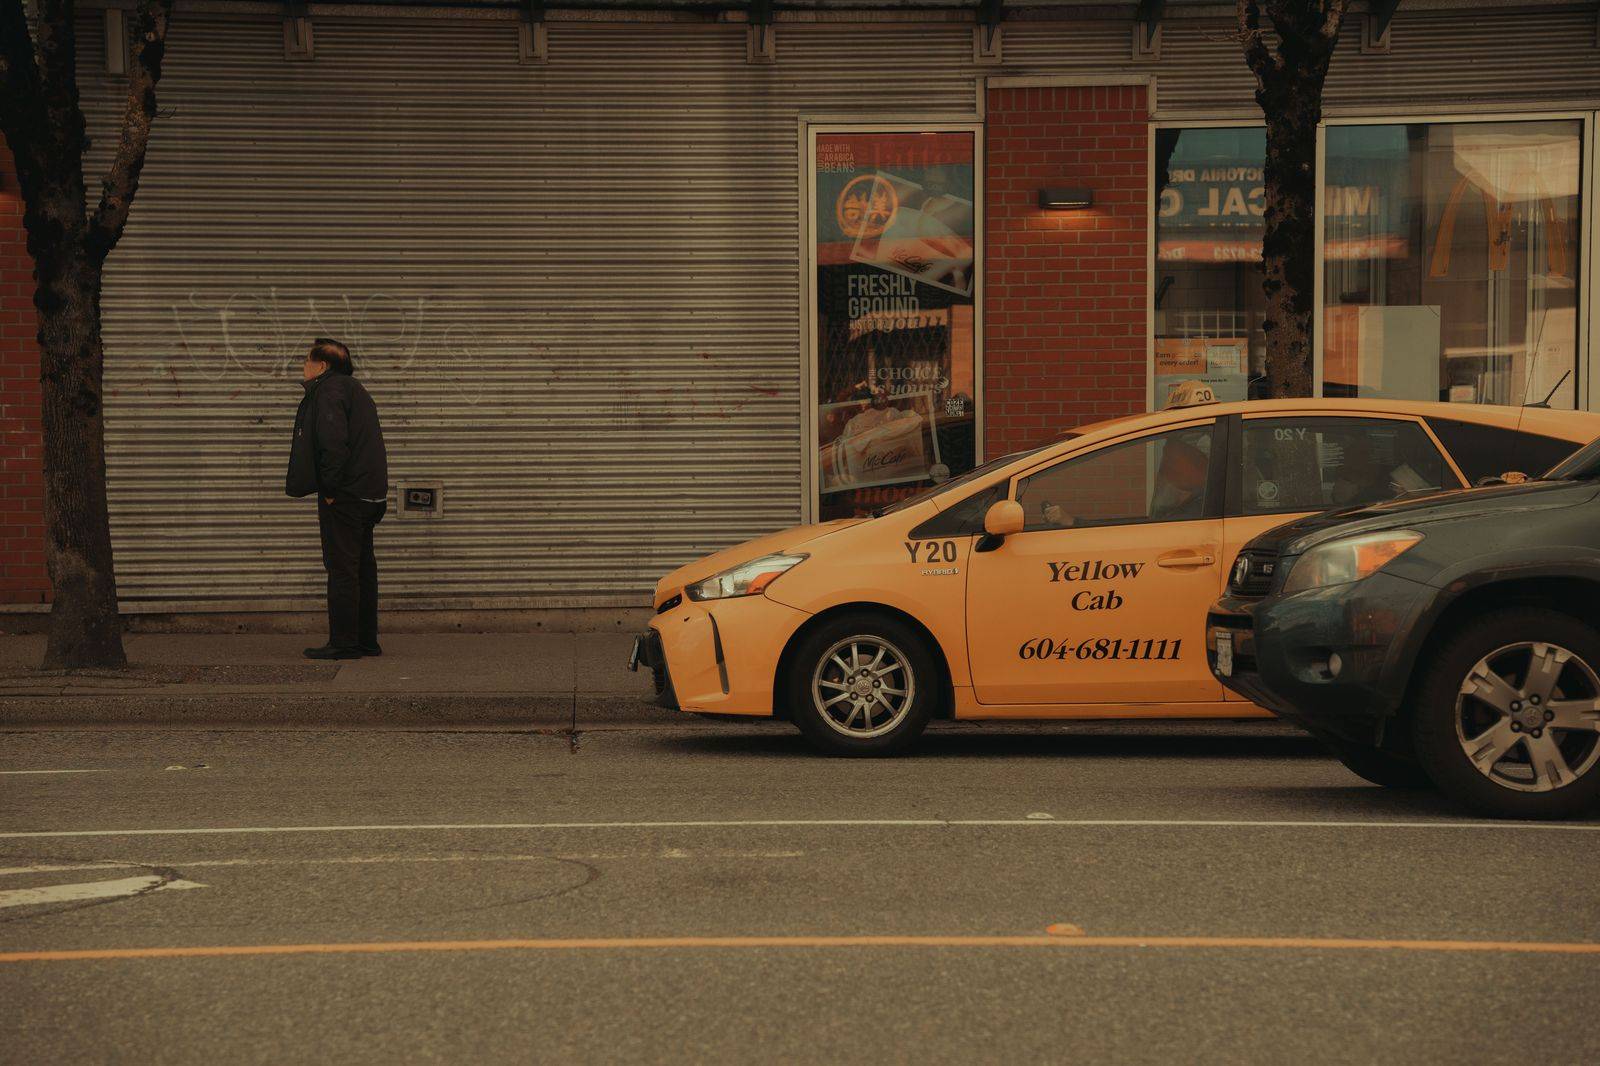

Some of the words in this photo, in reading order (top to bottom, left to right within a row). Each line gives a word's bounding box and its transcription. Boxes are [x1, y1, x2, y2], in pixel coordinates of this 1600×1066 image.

[834, 143, 850, 153] WITH
[824, 152, 855, 162] ARABICA
[824, 162, 856, 174] BEANS
[848, 273, 917, 296] FRESHLY
[848, 296, 920, 319] GROUND
[1159, 359, 1178, 367] every
[877, 367, 944, 380] CHOICE
[889, 382, 942, 397] yours
[1195, 390, 1212, 402] 20
[1047, 560, 1145, 582] Yellow
[1071, 590, 1123, 611] Cab
[1018, 637, 1182, 660] 604-681-1111
